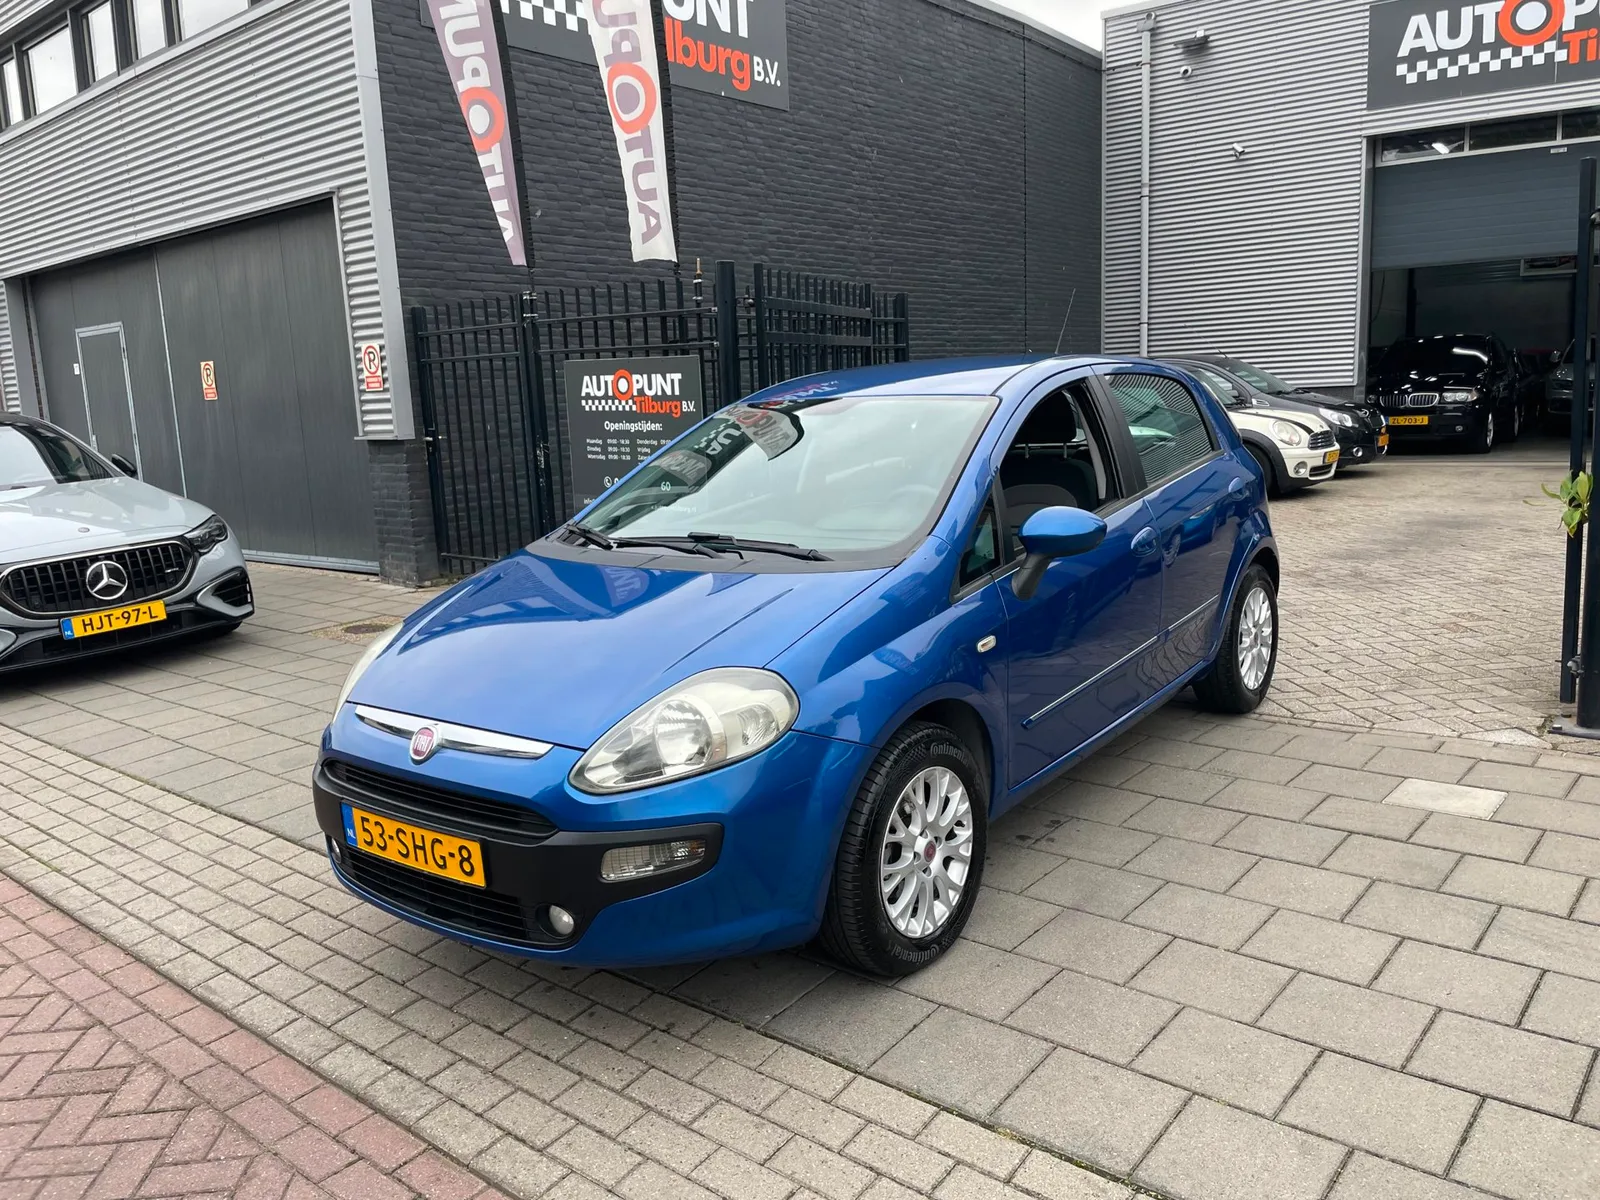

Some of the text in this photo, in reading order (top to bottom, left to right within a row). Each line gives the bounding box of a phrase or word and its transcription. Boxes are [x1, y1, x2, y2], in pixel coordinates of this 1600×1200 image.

[1397, 0, 1600, 57] AUTOP
[664, 16, 781, 91] lburg B.V.
[1562, 28, 1600, 64] Ti
[581, 369, 682, 400] AUTOPUNT
[634, 396, 696, 418] Tilburg B.V.
[604, 421, 663, 433] Openingstijden:
[660, 481, 671, 491] 60
[81, 605, 159, 633] HJT-97-L
[414, 734, 432, 752] FIAT
[347, 828, 356, 839] NL
[360, 816, 475, 877] 53-SHG-8
